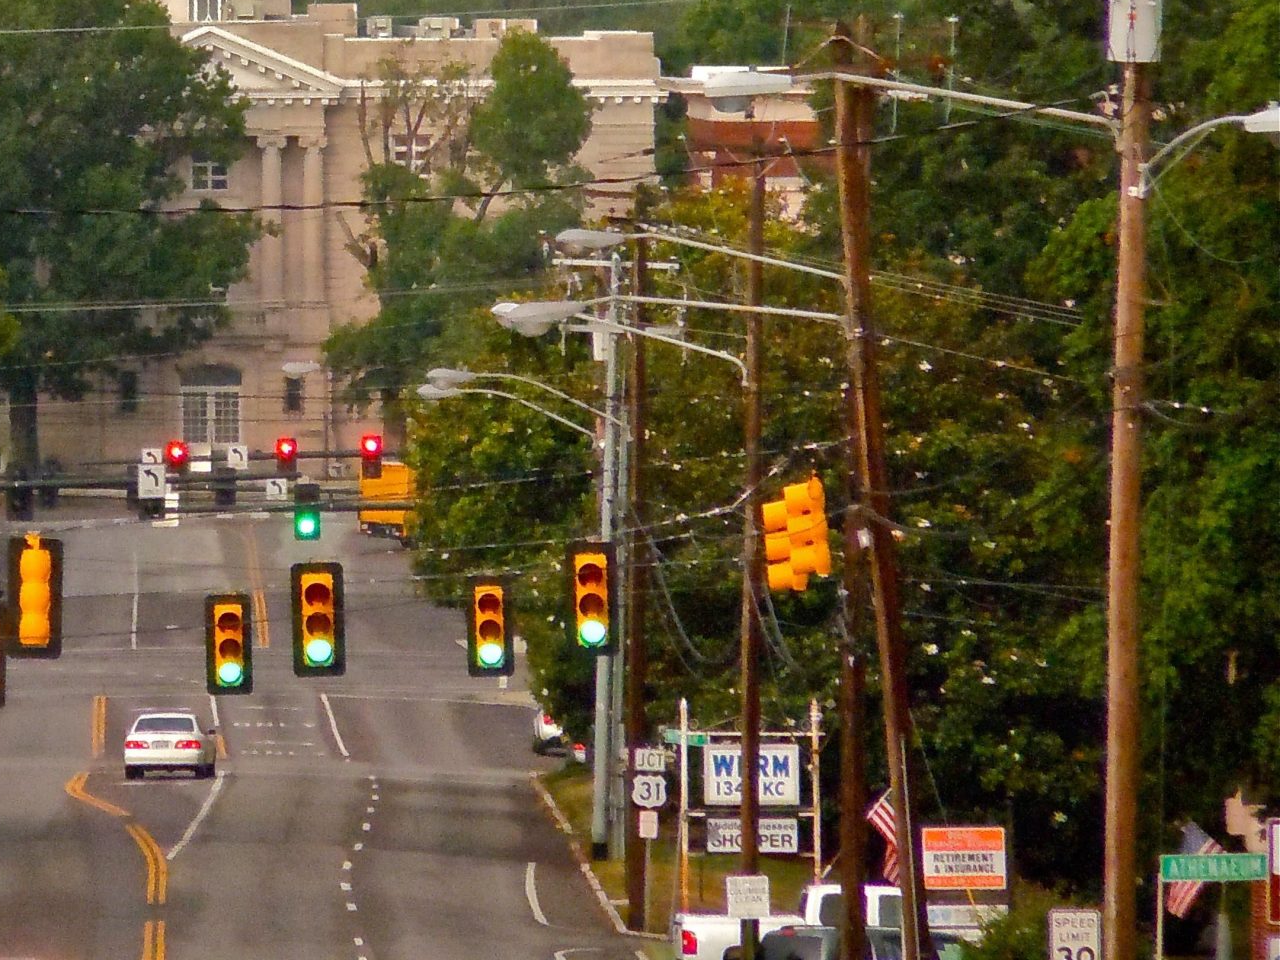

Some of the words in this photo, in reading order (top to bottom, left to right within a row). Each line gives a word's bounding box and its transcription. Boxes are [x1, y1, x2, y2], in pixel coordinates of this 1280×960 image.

[637, 752, 664, 767] JCT
[639, 781, 661, 801] 31
[715, 780, 743, 796] 134
[763, 781, 785, 796] KC
[711, 834, 793, 847] SHOPER
[933, 853, 994, 863] RETIREMENT
[944, 864, 995, 874] INSURANCE
[1054, 918, 1095, 928] SPEED
[1059, 932, 1090, 943] LIMIT
